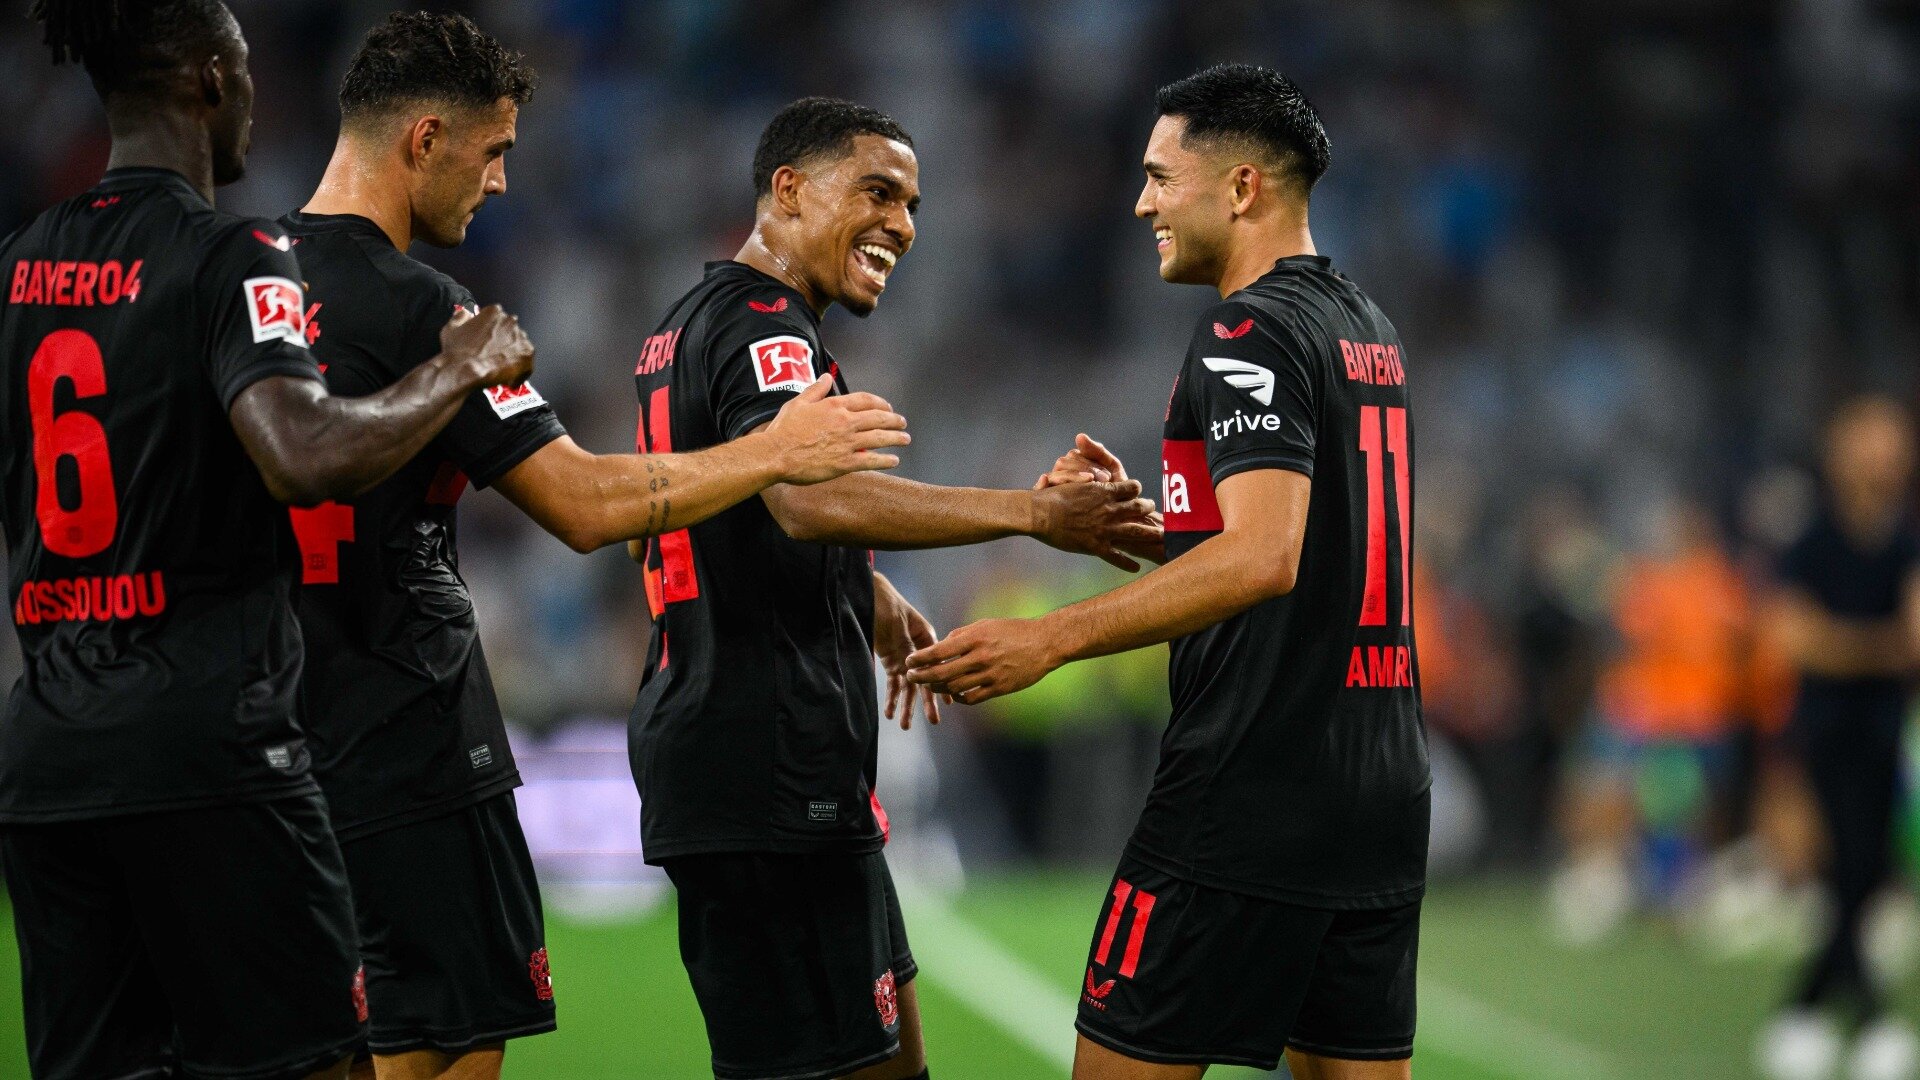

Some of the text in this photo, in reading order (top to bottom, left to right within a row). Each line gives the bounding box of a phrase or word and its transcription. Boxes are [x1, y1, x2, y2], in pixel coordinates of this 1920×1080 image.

[9, 259, 143, 306] BAYER04
[28, 328, 118, 558] 6
[1210, 409, 1281, 441] trive
[1163, 460, 1192, 514] ia
[1358, 405, 1410, 627] 11
[1094, 878, 1157, 979] 11
